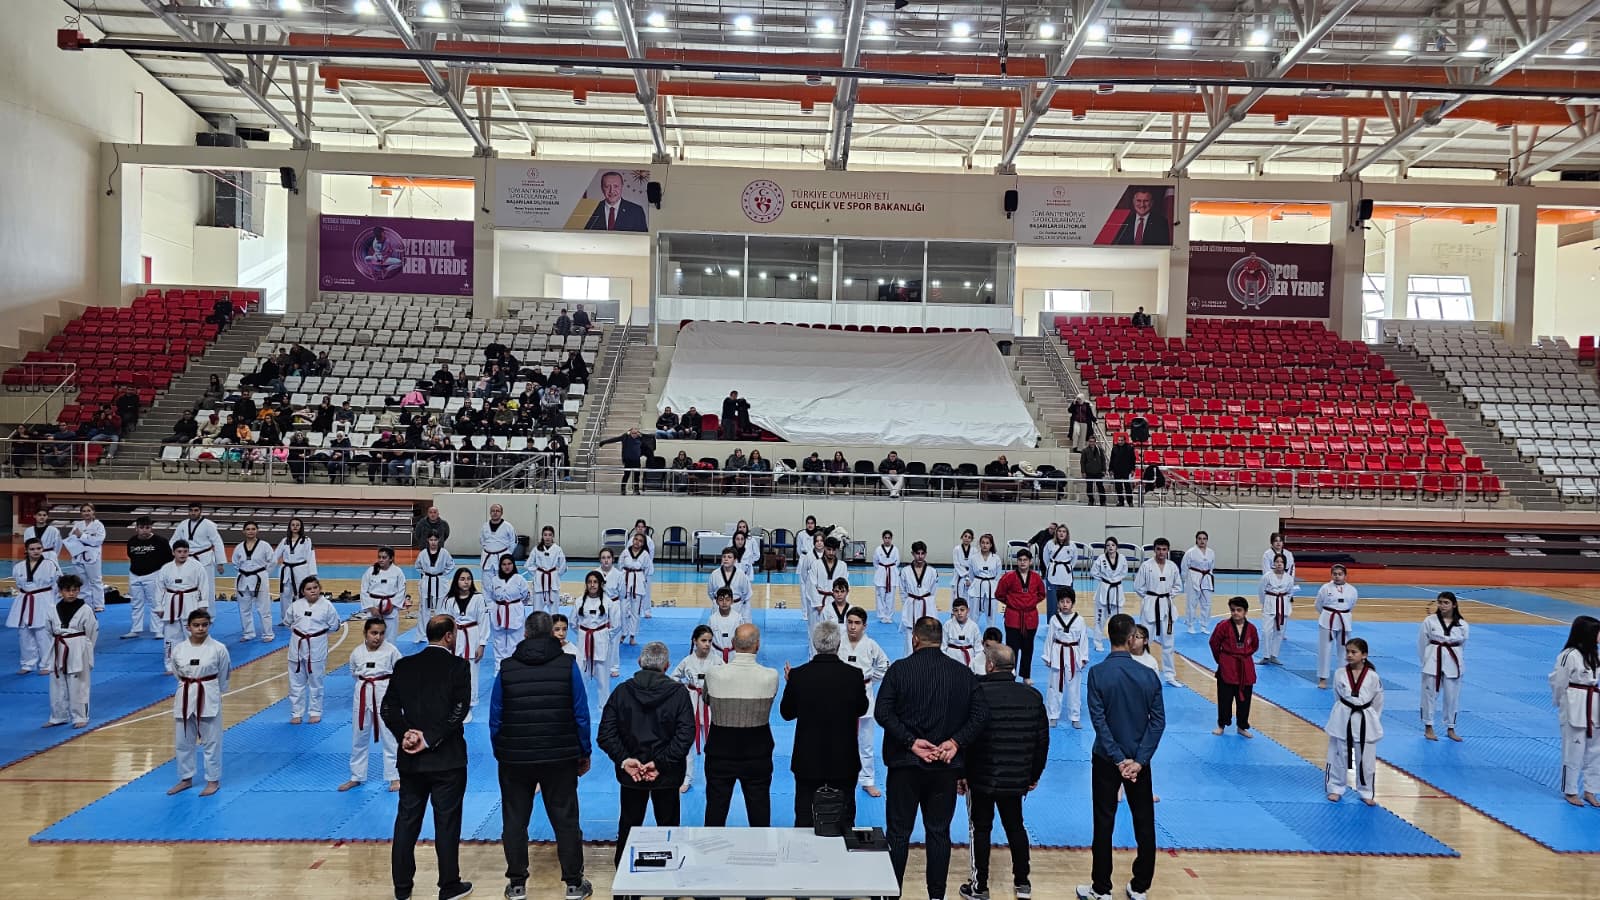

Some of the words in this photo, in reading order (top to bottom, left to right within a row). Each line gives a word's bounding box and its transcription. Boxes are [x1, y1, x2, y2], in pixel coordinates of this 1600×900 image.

[792, 189, 828, 200] TÜRKİYE
[829, 190, 890, 200] CUMHURİYETİ
[790, 200, 831, 212] GENÇLİK
[832, 201, 846, 210] VE
[847, 201, 872, 211] SPOR
[874, 201, 925, 212] BAKANLIĞI
[402, 238, 456, 257] YETENEK
[401, 256, 426, 274] HER
[429, 257, 468, 276] YERDE
[1268, 264, 1299, 280] SPOR
[1291, 281, 1325, 297] YERDE
